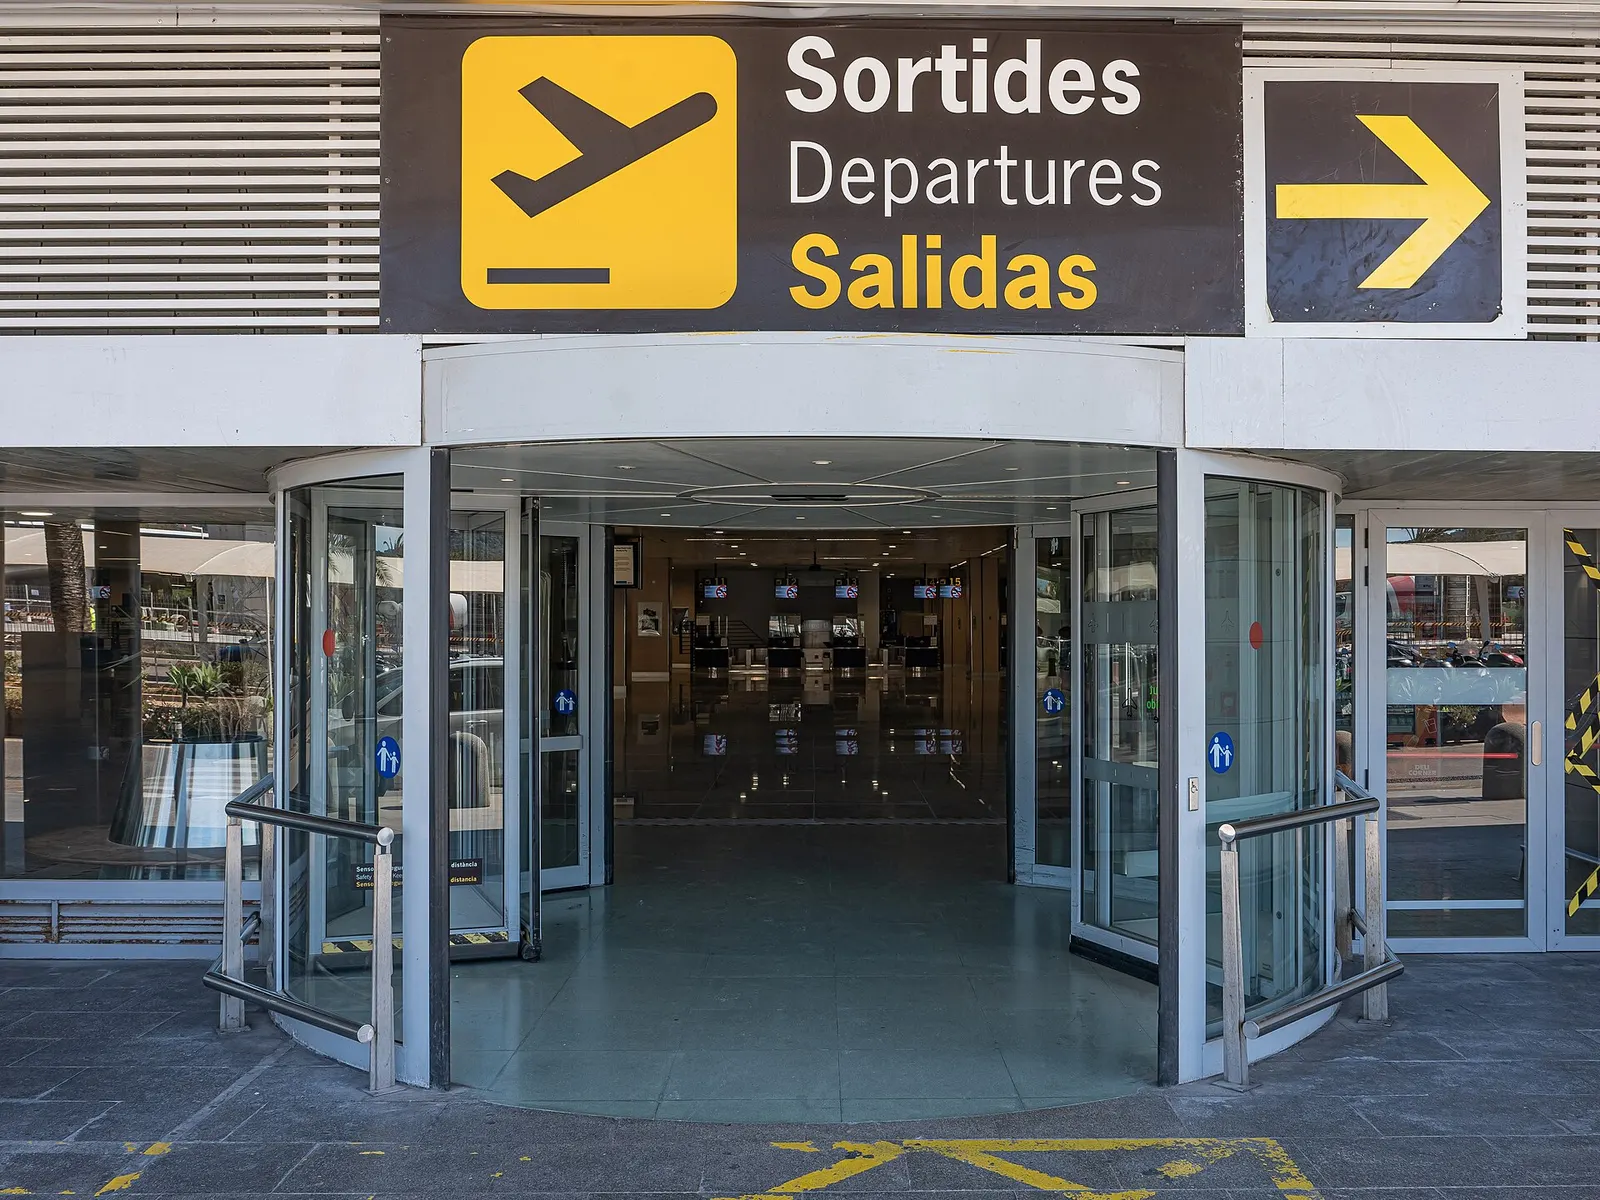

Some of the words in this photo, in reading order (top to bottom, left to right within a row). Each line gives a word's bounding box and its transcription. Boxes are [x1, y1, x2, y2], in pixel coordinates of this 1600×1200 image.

[785, 36, 1141, 115] Sortides
[790, 140, 1162, 217] Departures
[789, 232, 1098, 310] Salidas
[714, 577, 725, 585] 11
[786, 577, 797, 585] 12
[949, 577, 961, 586] 15
